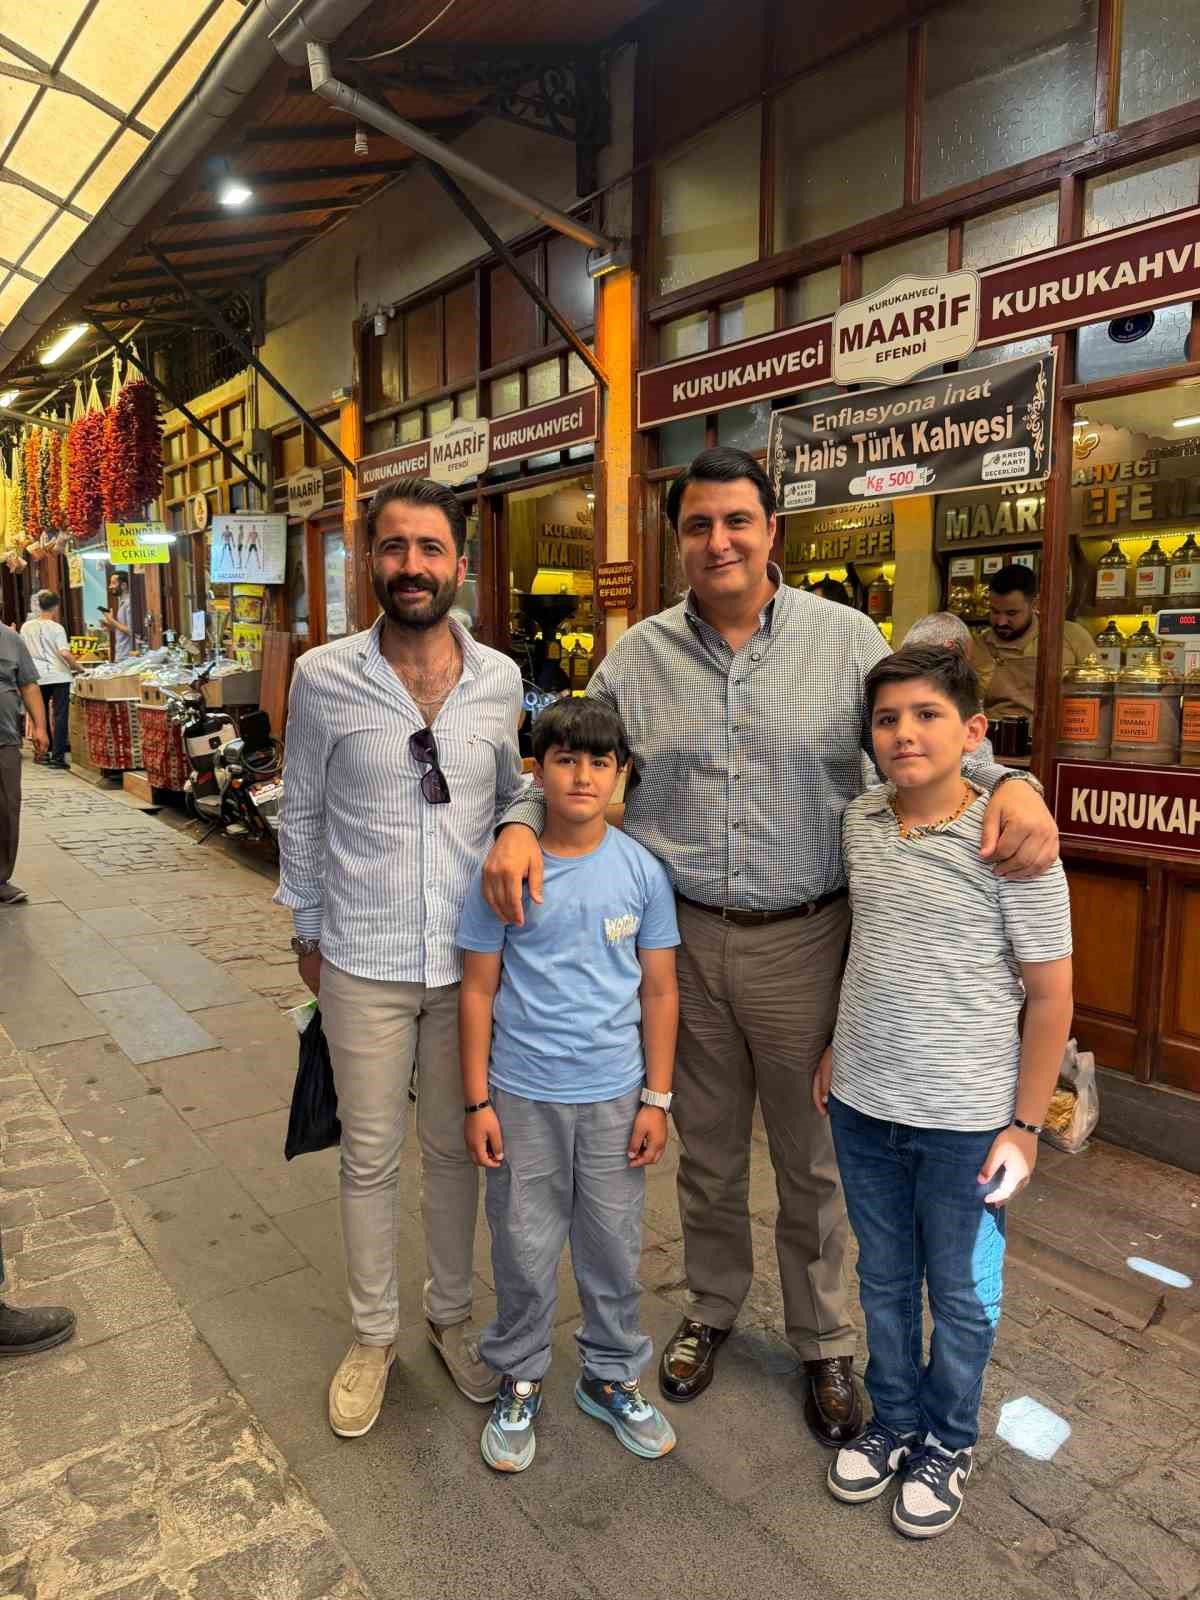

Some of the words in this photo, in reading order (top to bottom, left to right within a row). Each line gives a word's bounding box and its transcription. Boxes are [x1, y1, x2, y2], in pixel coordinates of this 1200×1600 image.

[868, 286, 939, 313] KURUKAHVECİ
[839, 293, 971, 354] MAARİF
[875, 339, 926, 363] EFENDİ
[672, 339, 824, 403] KURUKAHVECİ
[811, 395, 936, 433] Enflasyona
[943, 379, 992, 406] inat
[492, 407, 583, 451] KURUKAHVECİ
[794, 438, 848, 474] Halis
[852, 426, 906, 464] Türk
[912, 405, 1014, 455] Kahvesi
[433, 431, 486, 464] MAARİF
[363, 452, 429, 484] KURUKAHVECİ
[867, 475, 884, 492] Kg
[888, 470, 914, 488] 500
[855, 528, 895, 556] EFE
